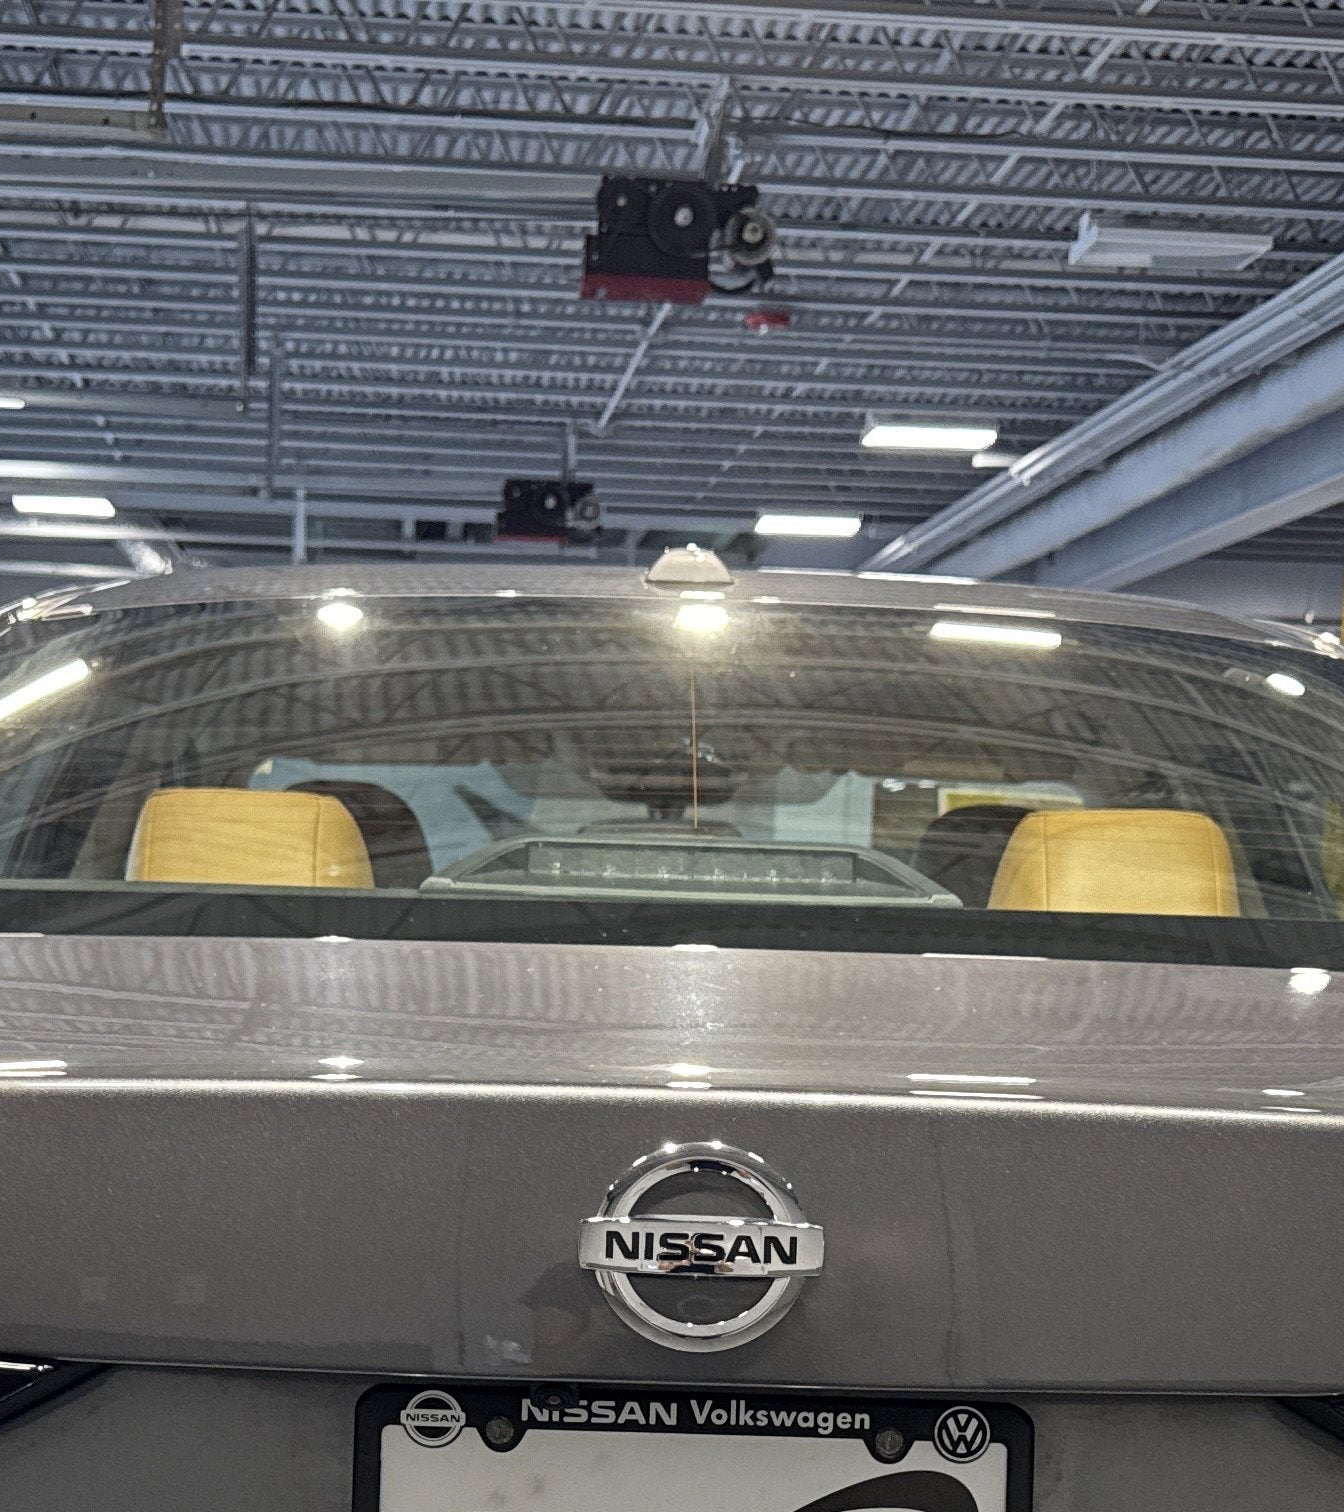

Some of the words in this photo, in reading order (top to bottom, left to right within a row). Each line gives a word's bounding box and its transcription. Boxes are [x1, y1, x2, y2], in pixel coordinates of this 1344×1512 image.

[604, 1230, 798, 1265] NISSAN
[405, 1412, 460, 1424] NISSAN
[689, 1399, 871, 1435] Volkswagen
